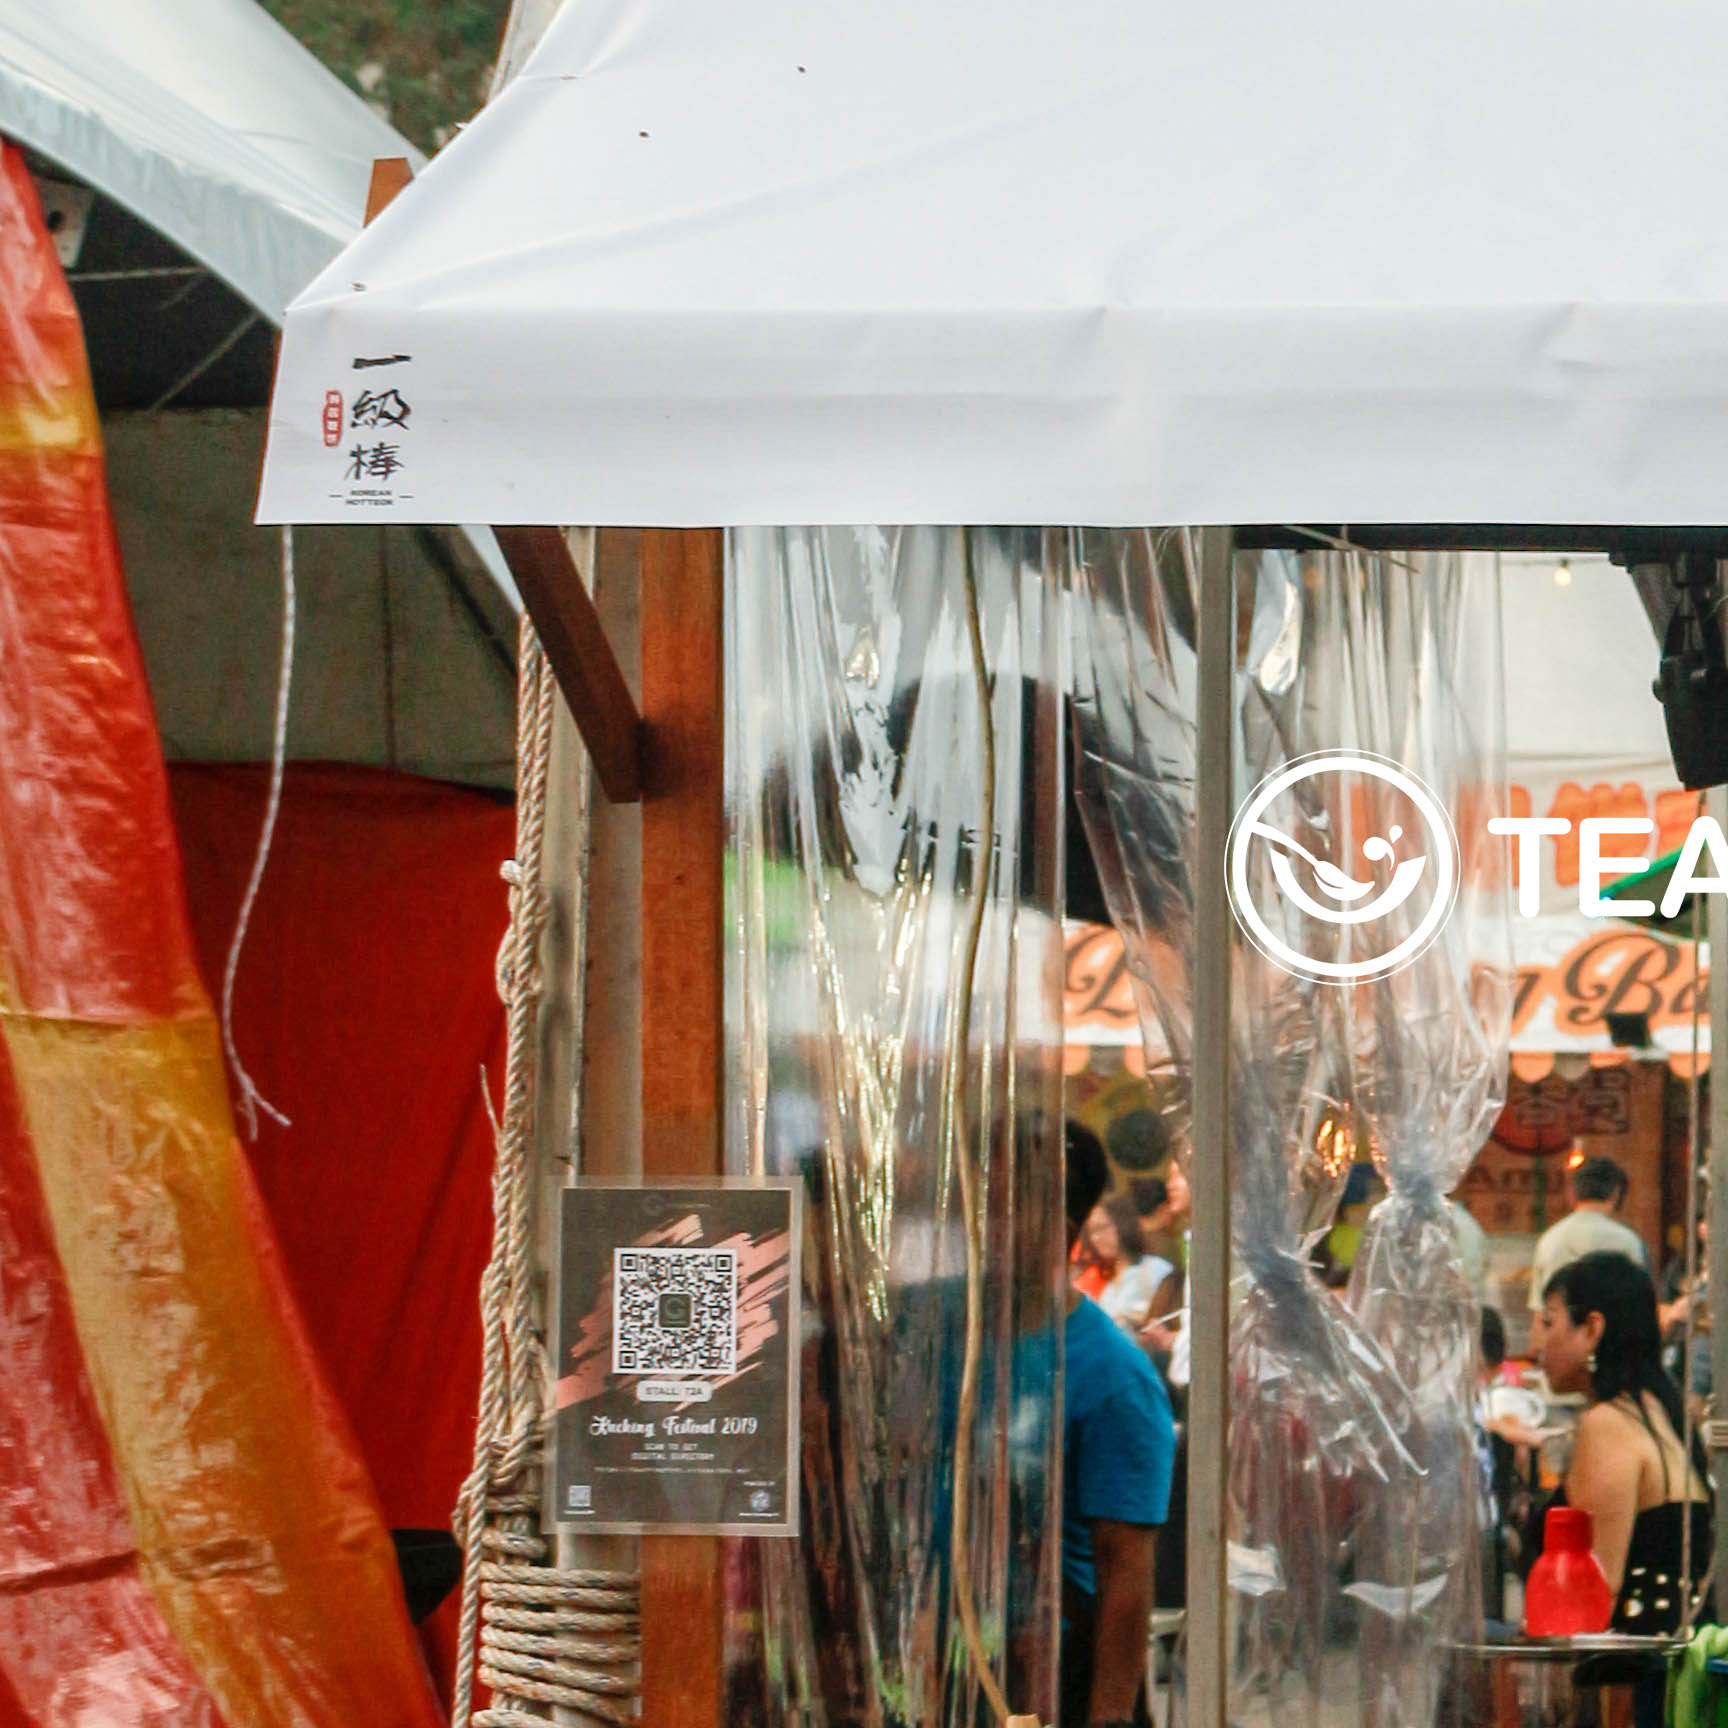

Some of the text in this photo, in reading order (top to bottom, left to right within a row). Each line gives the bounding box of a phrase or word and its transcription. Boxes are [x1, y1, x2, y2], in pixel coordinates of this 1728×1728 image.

[344, 353, 413, 481] 一級棒
[661, 1415, 716, 1436] Festival
[720, 1416, 759, 1435] 2019
